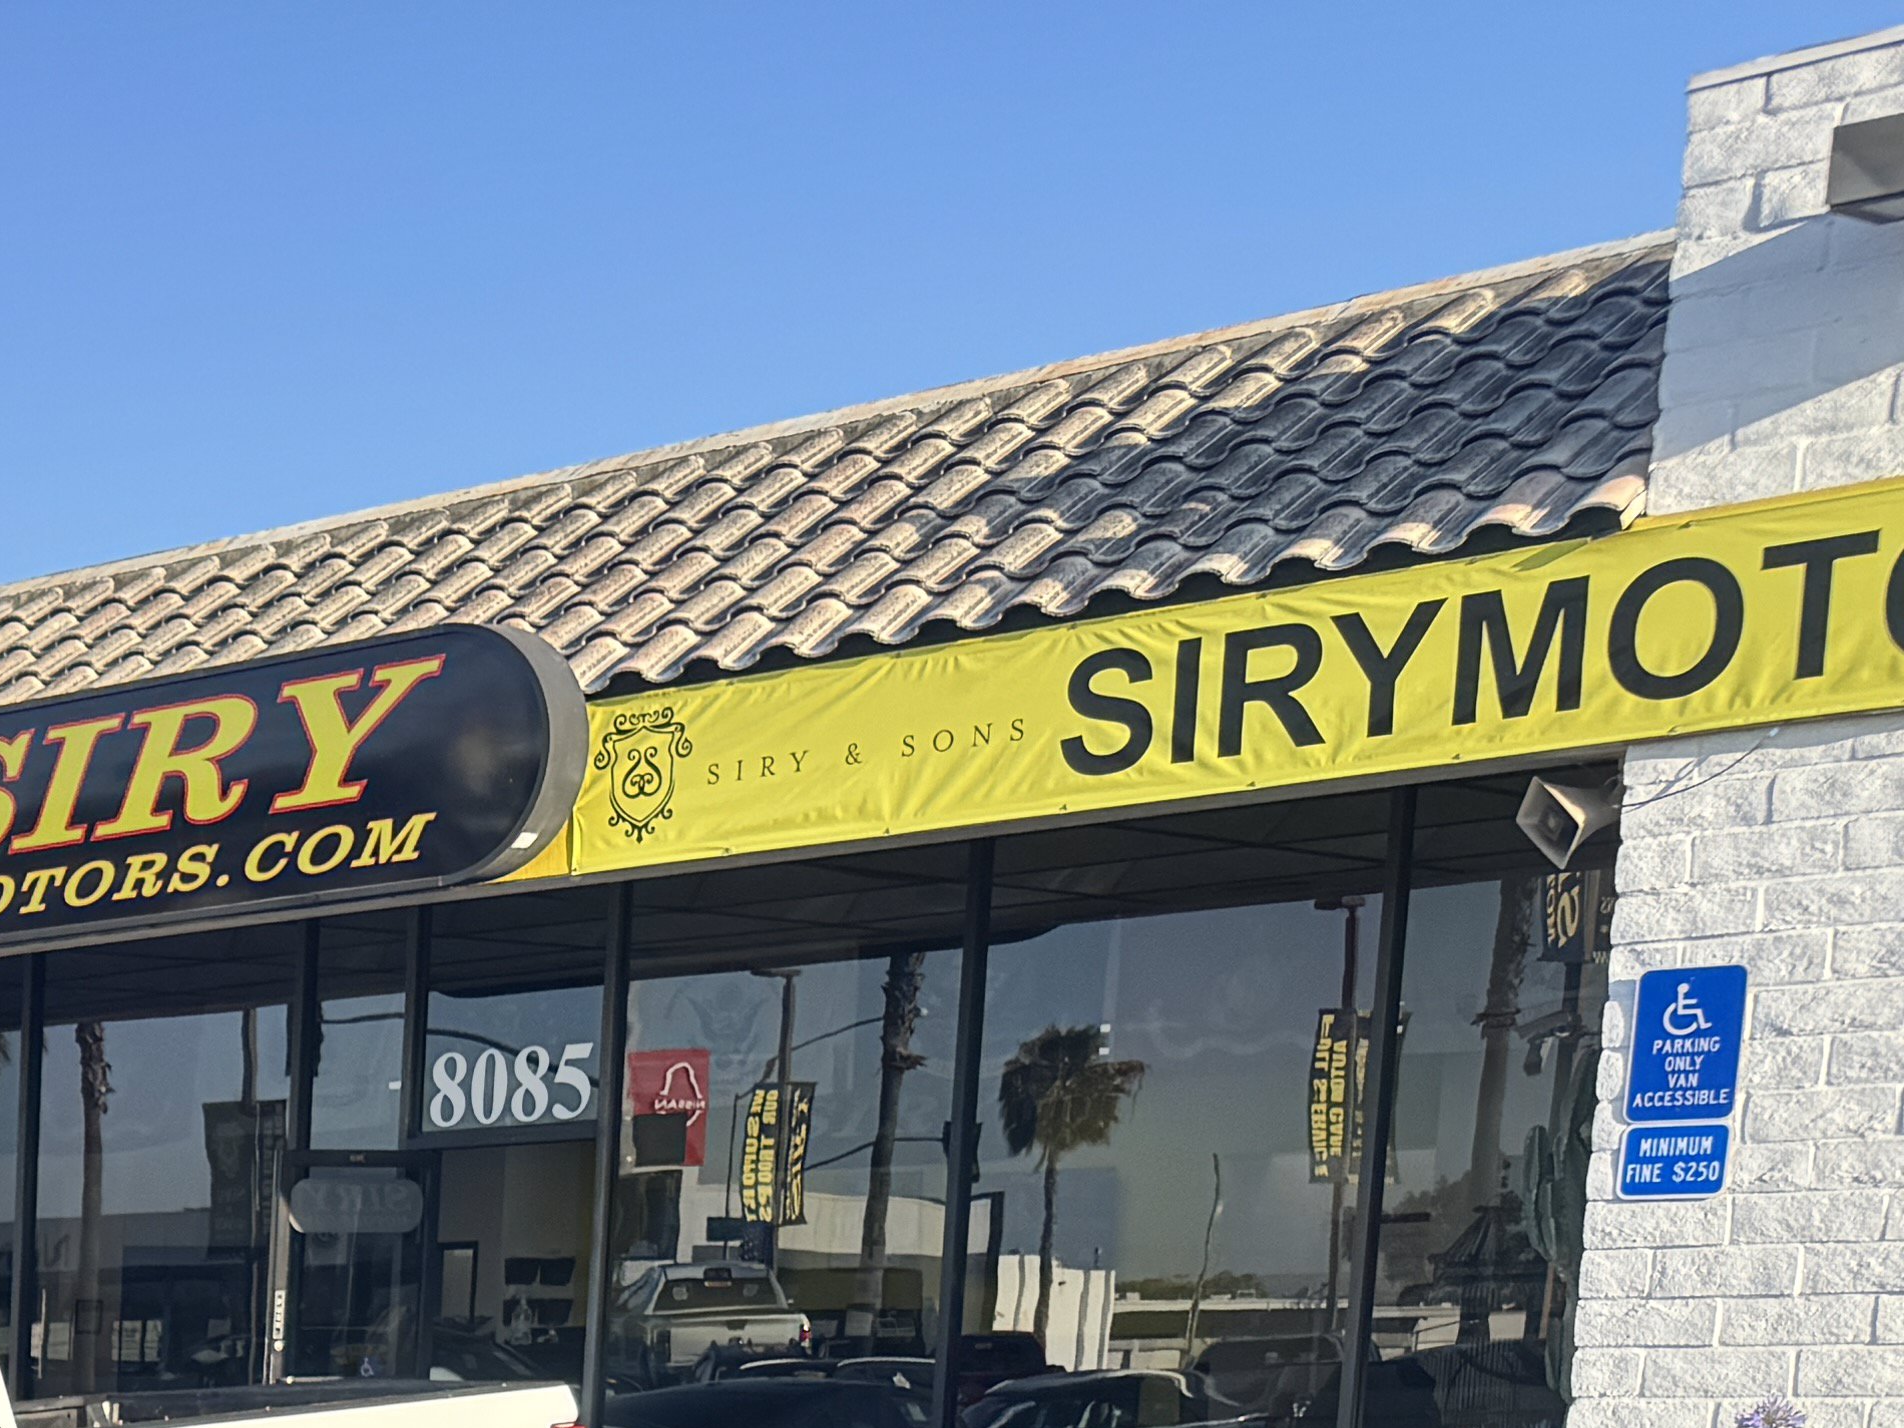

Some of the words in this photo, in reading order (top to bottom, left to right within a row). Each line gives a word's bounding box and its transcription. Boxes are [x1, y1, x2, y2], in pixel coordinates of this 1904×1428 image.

[1060, 529, 1904, 776] SIRYMOT
[707, 749, 809, 787] SIRY
[845, 741, 865, 767] &
[900, 718, 1028, 757] SONS
[1653, 1037, 1720, 1055] PARKING
[1664, 1055, 1704, 1072] ONLY
[430, 1042, 594, 1128] 8085
[1667, 1073, 1698, 1088] VAN
[1632, 1088, 1730, 1107] ACCESSIBLE
[1639, 1136, 1713, 1157] MINIMUM
[1626, 1164, 1662, 1184] FINE
[1672, 1160, 1720, 1183] $250
